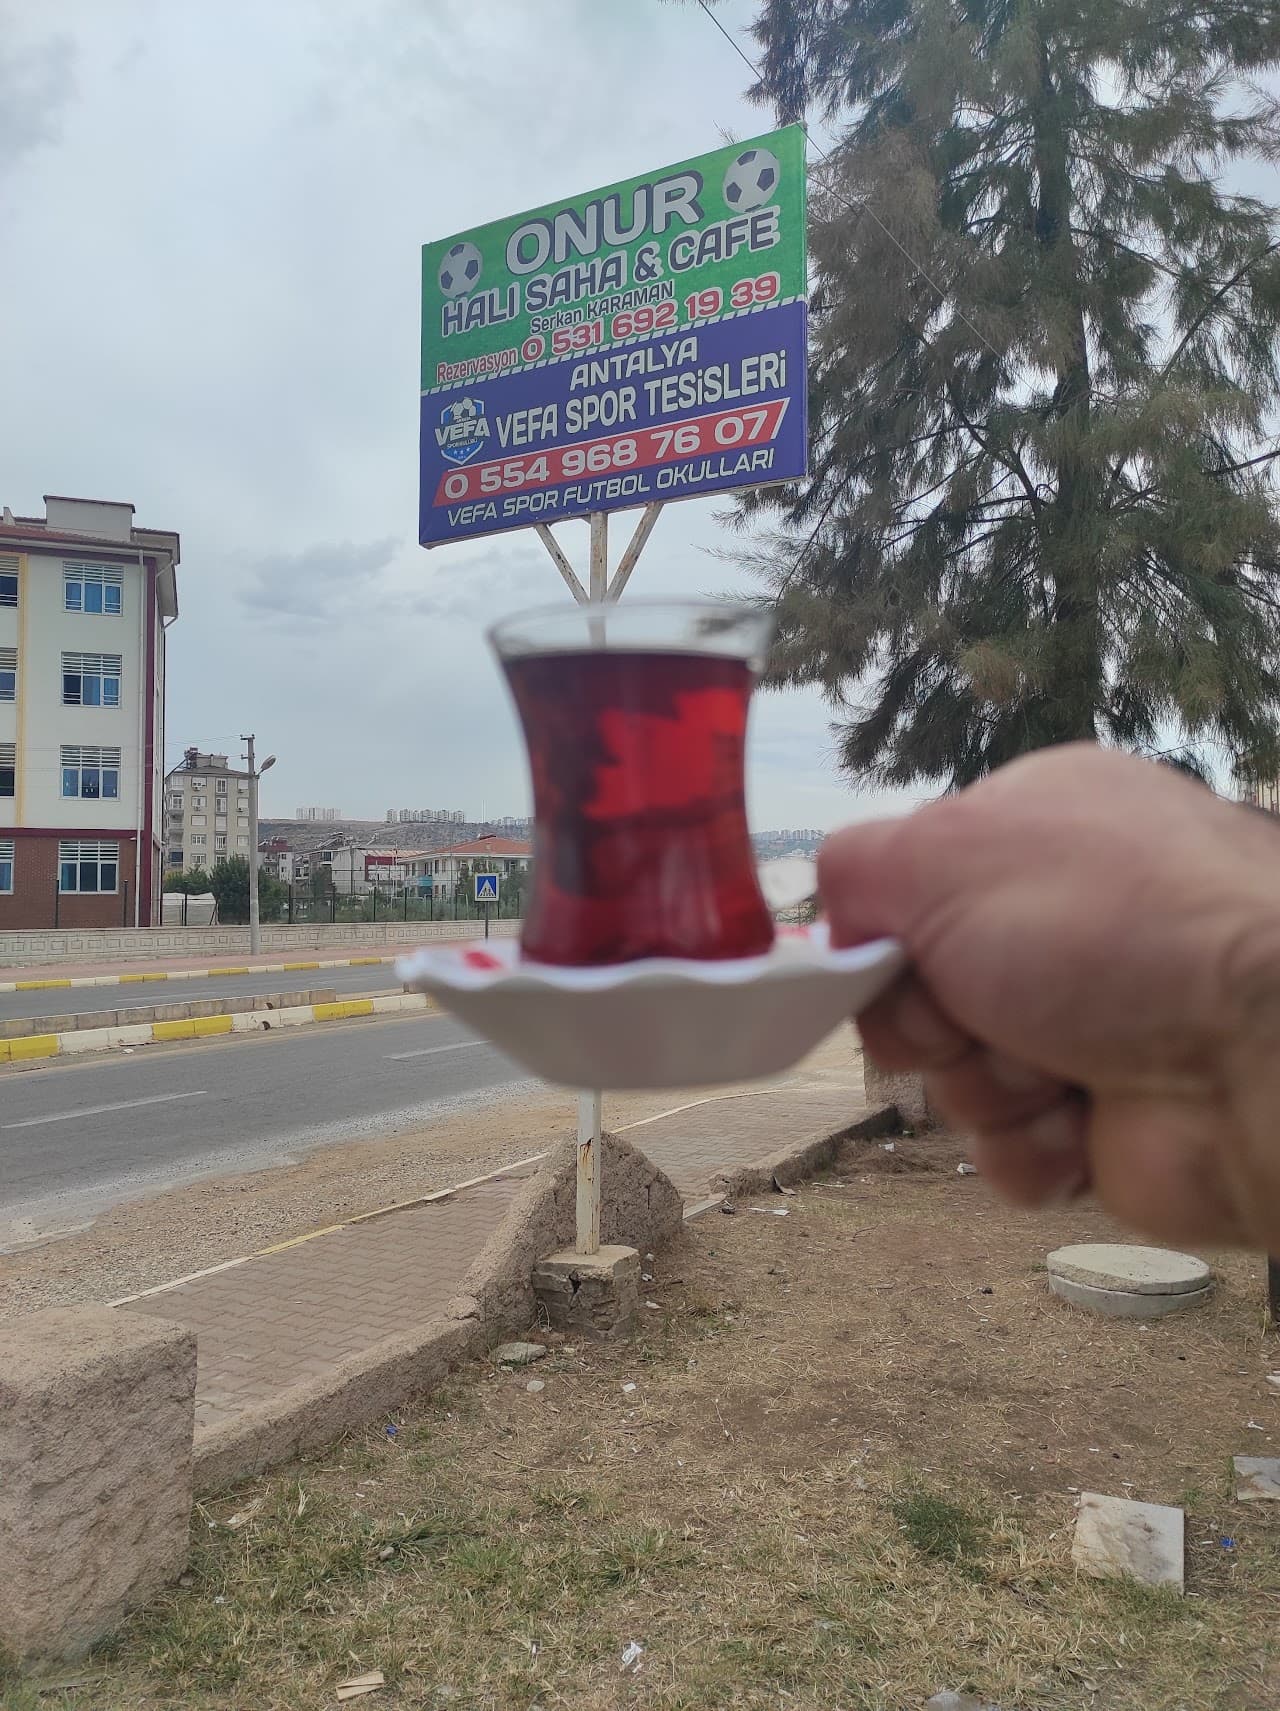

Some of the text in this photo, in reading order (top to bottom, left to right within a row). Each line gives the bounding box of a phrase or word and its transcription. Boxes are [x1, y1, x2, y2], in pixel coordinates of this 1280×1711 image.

[506, 170, 704, 275] ONUR
[442, 206, 780, 337] HALI SAHA & CAFE
[531, 281, 673, 334] Serkan KARAMAN
[437, 349, 517, 384] Rezervasyon
[552, 320, 604, 354] 531
[612, 300, 677, 339] 692
[685, 289, 722, 320] 19
[731, 272, 780, 308] 39
[570, 337, 698, 391] ANTALYA
[435, 418, 490, 446] VEFA
[480, 456, 549, 491] 554
[561, 439, 637, 476] 968
[650, 425, 700, 459] 76
[715, 410, 767, 445] 07
[496, 404, 557, 448] VEFA
[566, 385, 637, 434] SPOR
[447, 447, 774, 526] VEFA SPOR FUTBOL OKULLARI
